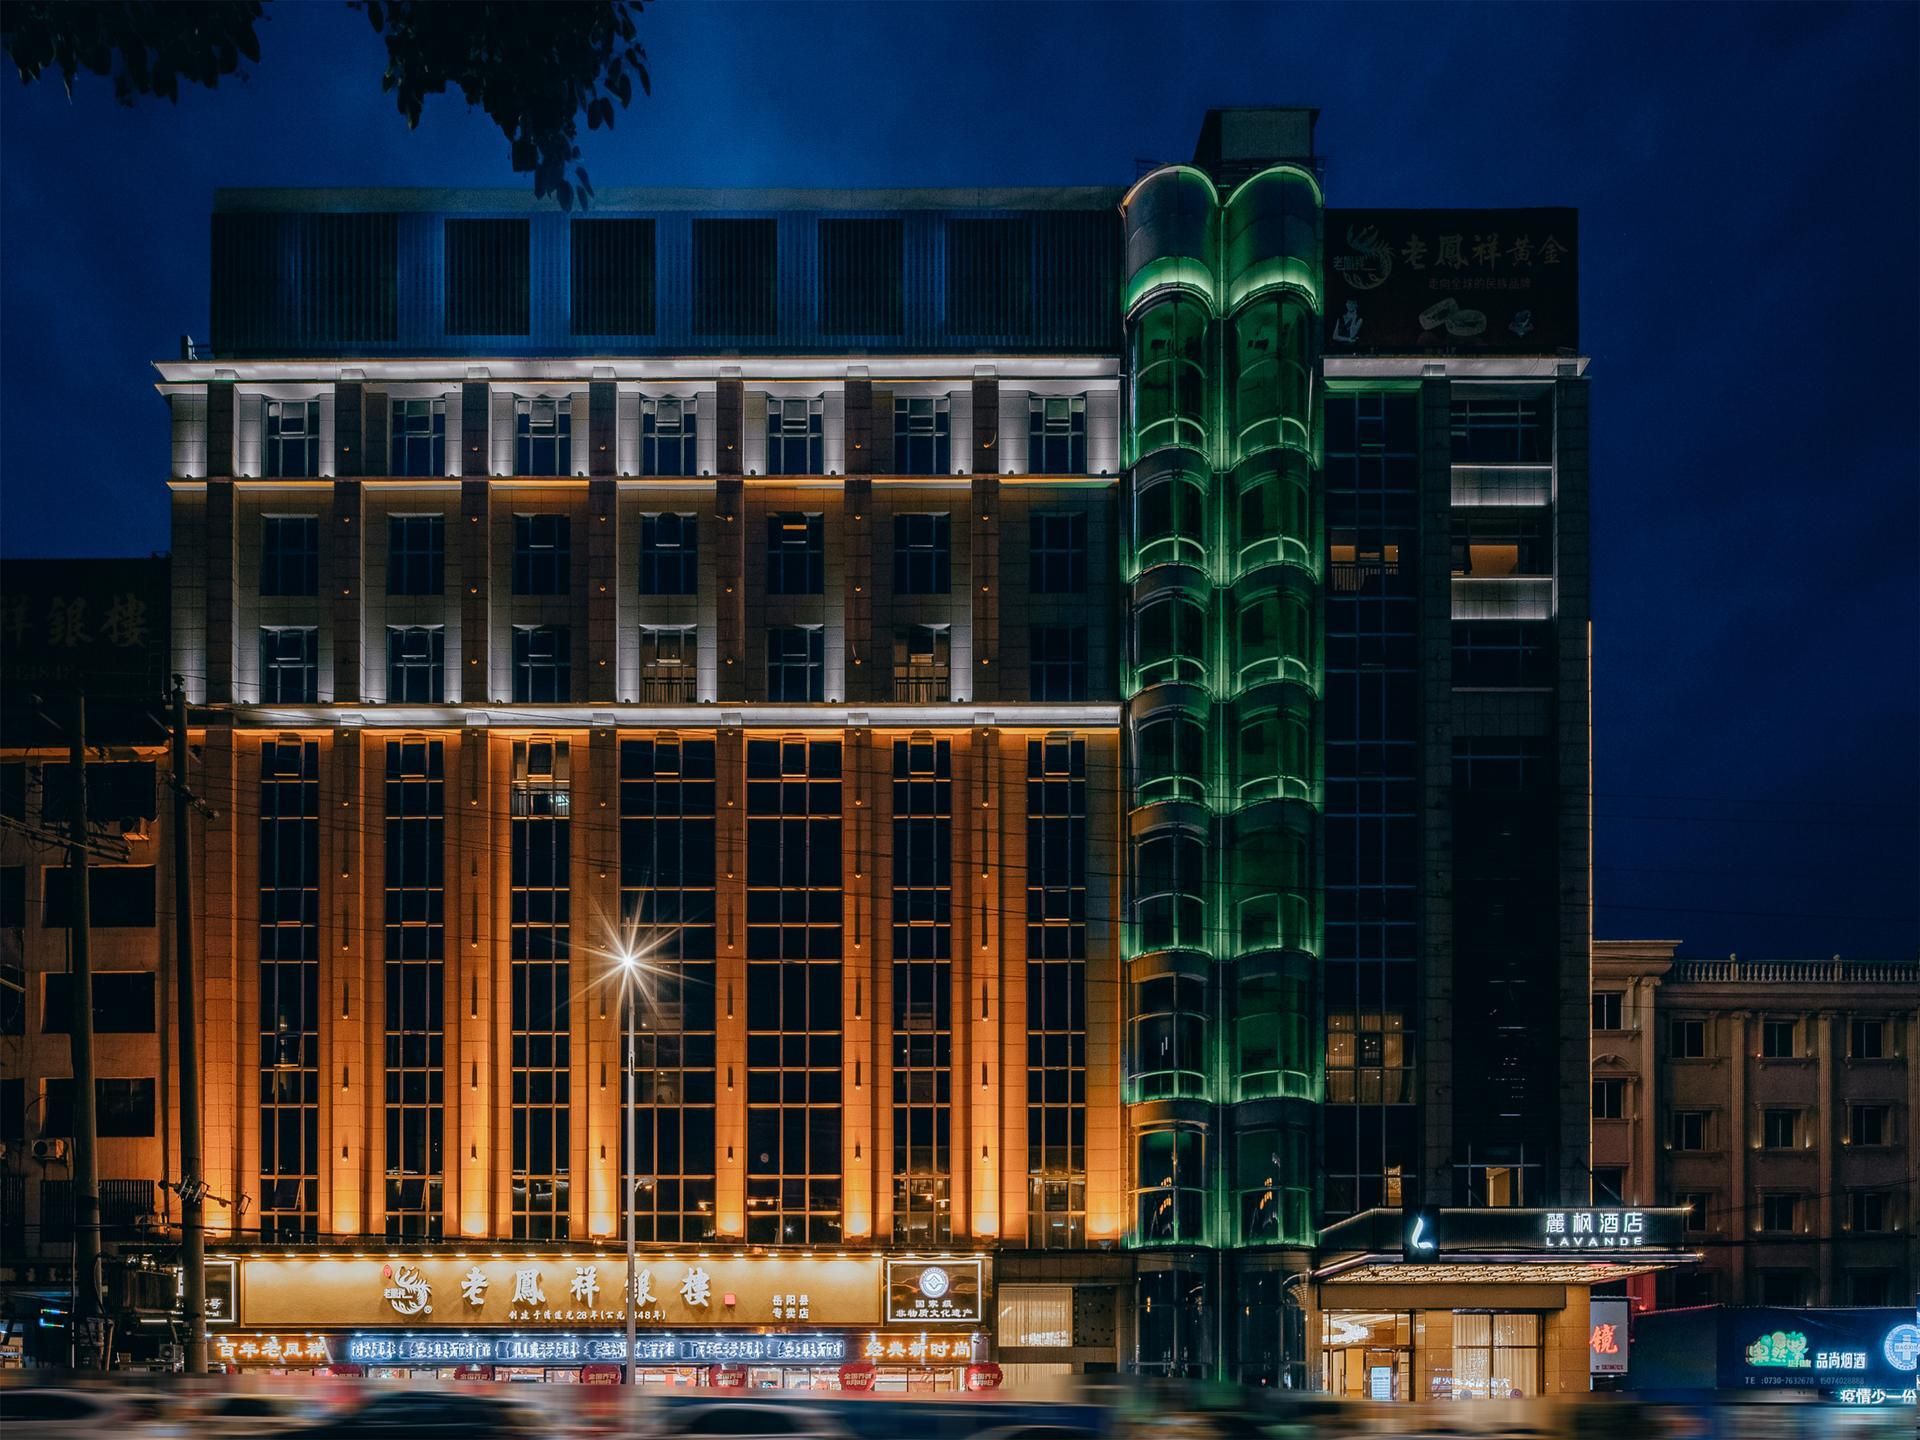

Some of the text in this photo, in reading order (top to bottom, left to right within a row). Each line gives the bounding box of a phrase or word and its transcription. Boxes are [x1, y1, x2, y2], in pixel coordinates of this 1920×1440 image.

[1546, 1212, 1643, 1233] 麗枫酒店
[1546, 1237, 1642, 1246] LAVANDE
[772, 1294, 809, 1306] 岳阳县
[914, 1299, 954, 1309] 国家级
[772, 1307, 809, 1319] 专卖店
[895, 1309, 974, 1318] 非物质文化遗产
[217, 1340, 325, 1359] 百年老凤祥
[865, 1341, 971, 1358] 经典新时尚
[1816, 1352, 1866, 1369] 品尚烟酒
